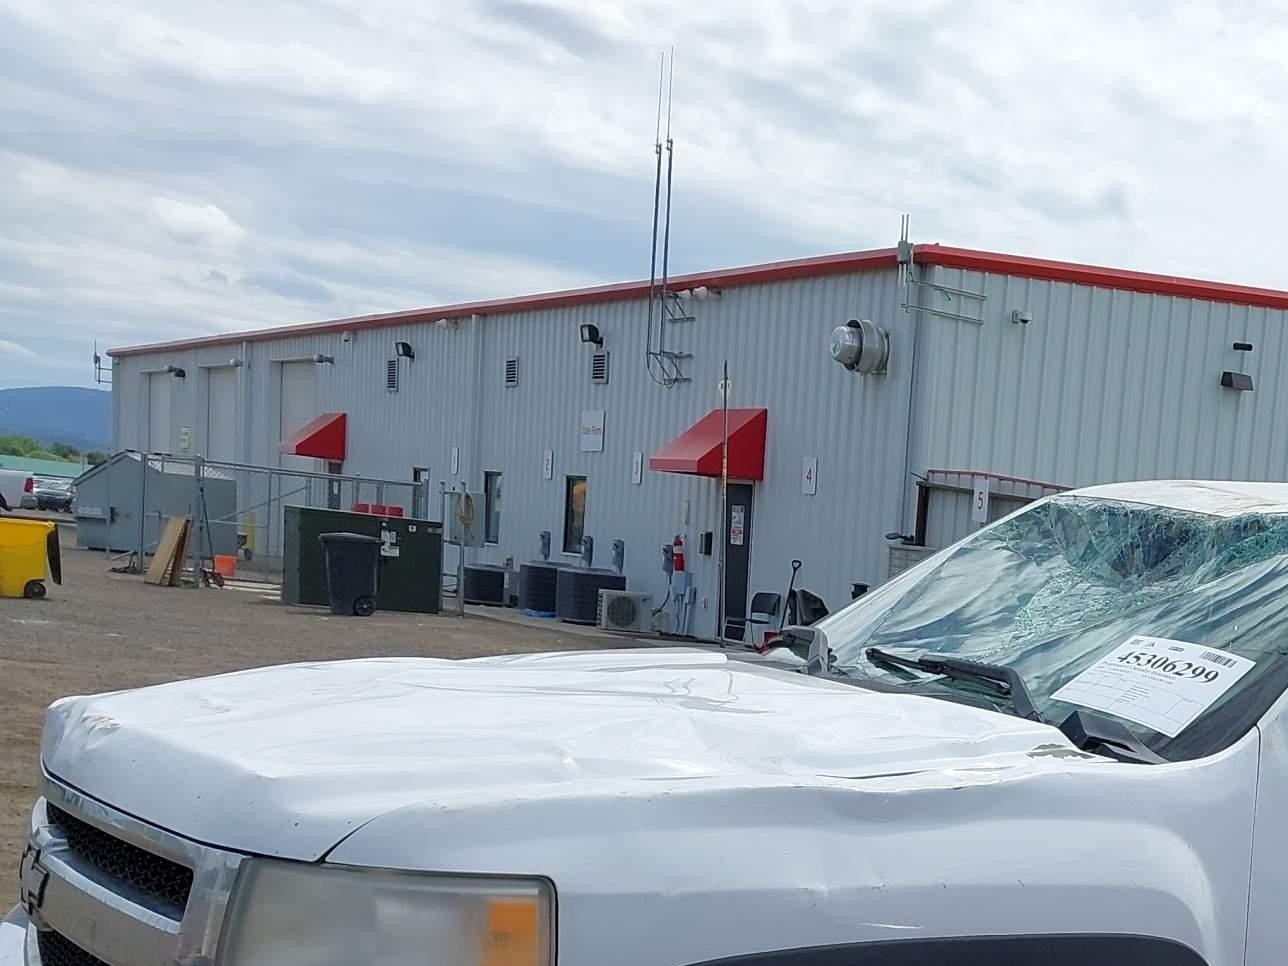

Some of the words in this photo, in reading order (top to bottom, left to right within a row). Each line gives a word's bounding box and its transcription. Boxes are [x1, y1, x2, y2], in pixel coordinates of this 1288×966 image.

[806, 467, 813, 484] 4
[977, 491, 985, 510] 5
[1116, 650, 1220, 684] 45306299
